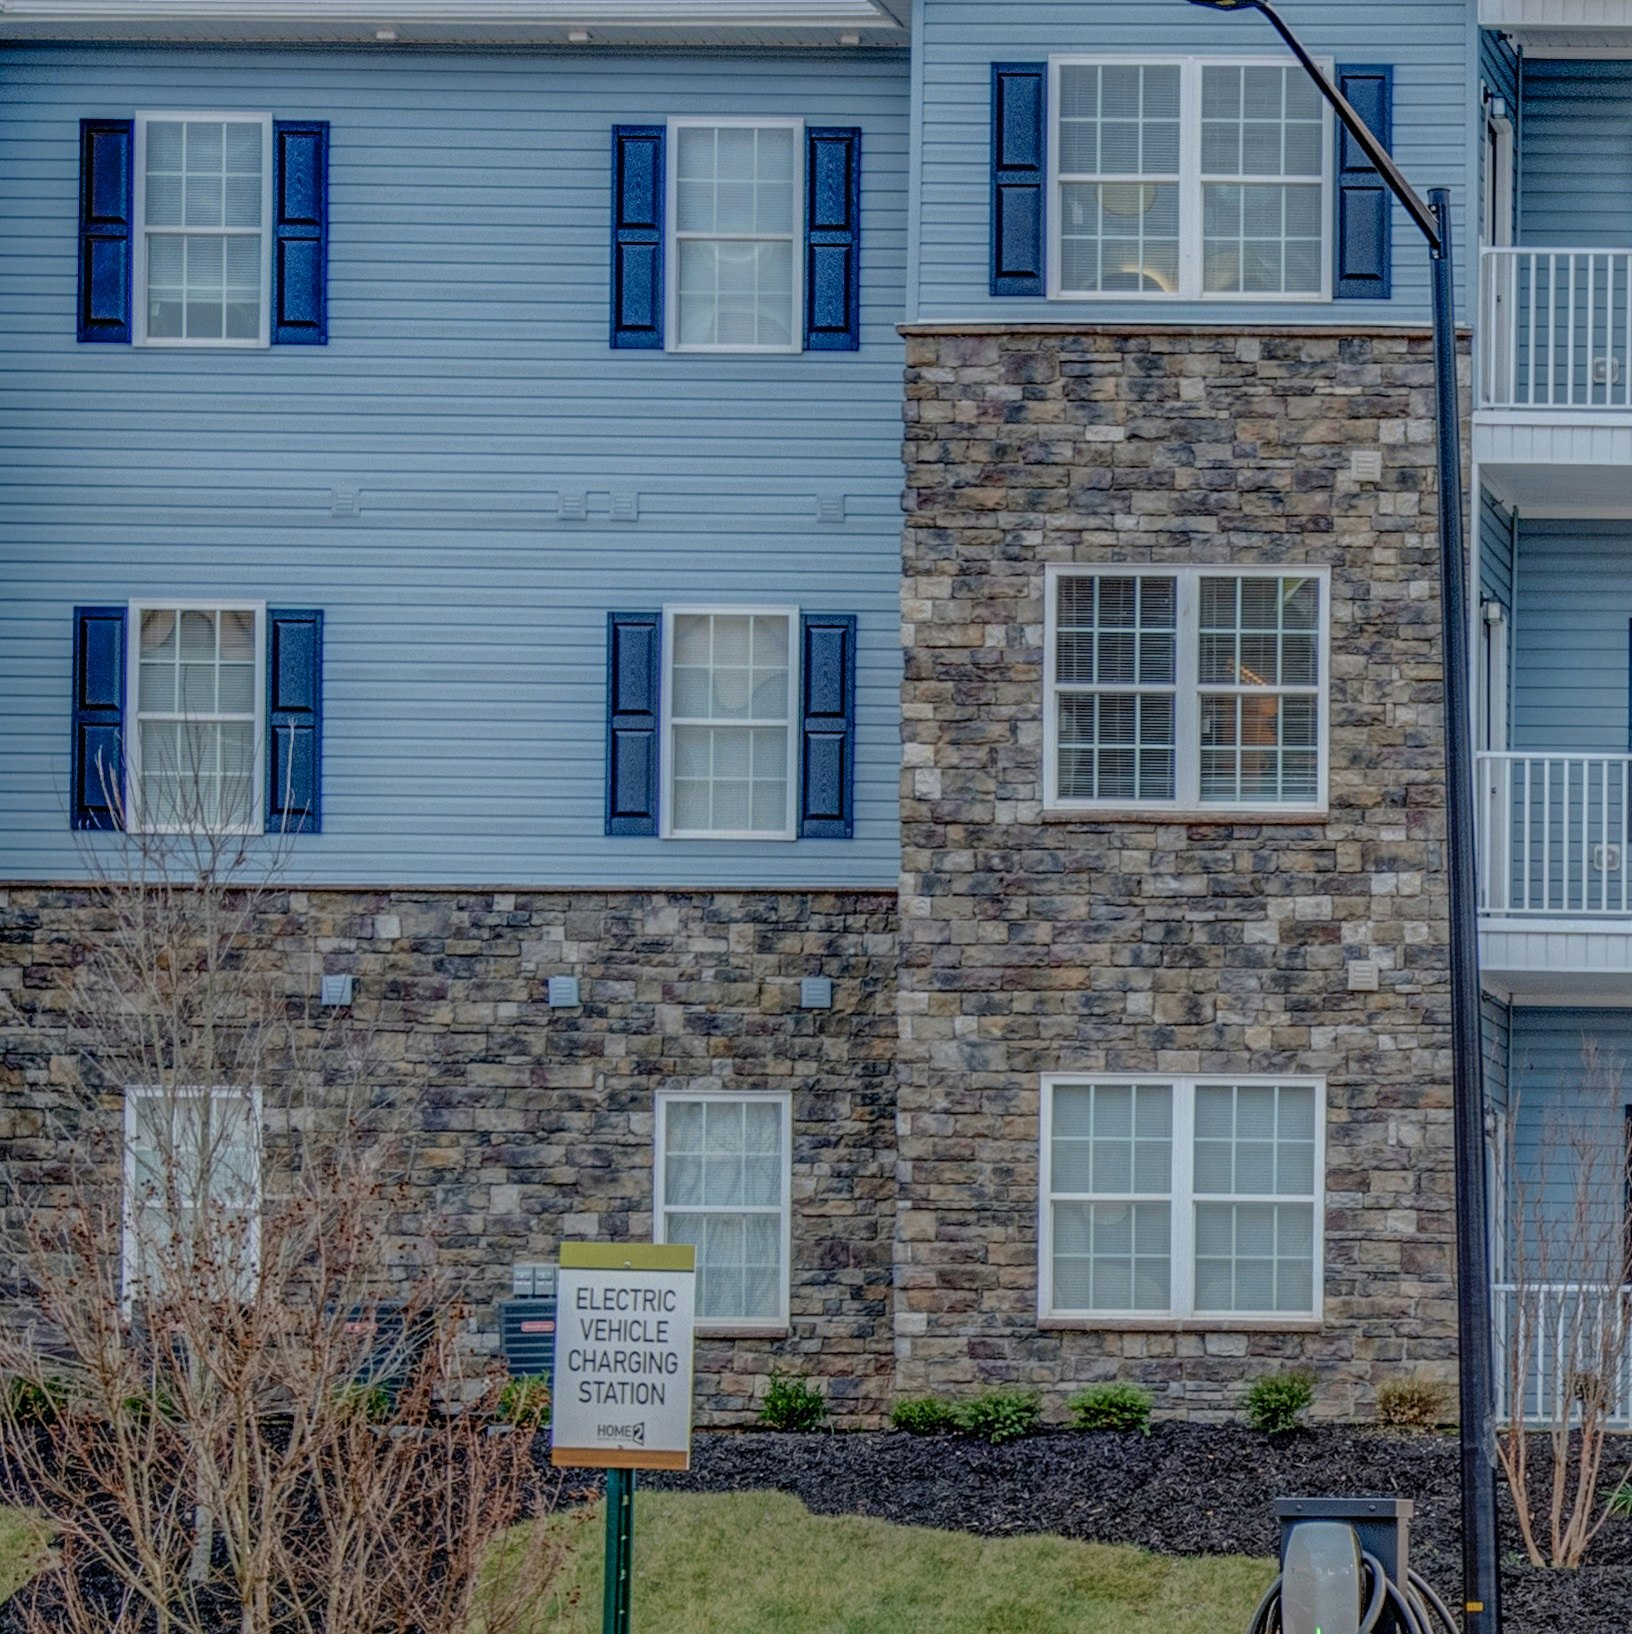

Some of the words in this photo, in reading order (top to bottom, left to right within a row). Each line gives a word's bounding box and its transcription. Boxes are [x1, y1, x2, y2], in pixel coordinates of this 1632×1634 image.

[576, 1287, 677, 1312] ELECTRIC
[580, 1318, 669, 1343] VEHICLE
[568, 1349, 678, 1375] CHARGING
[578, 1381, 666, 1405] STATION
